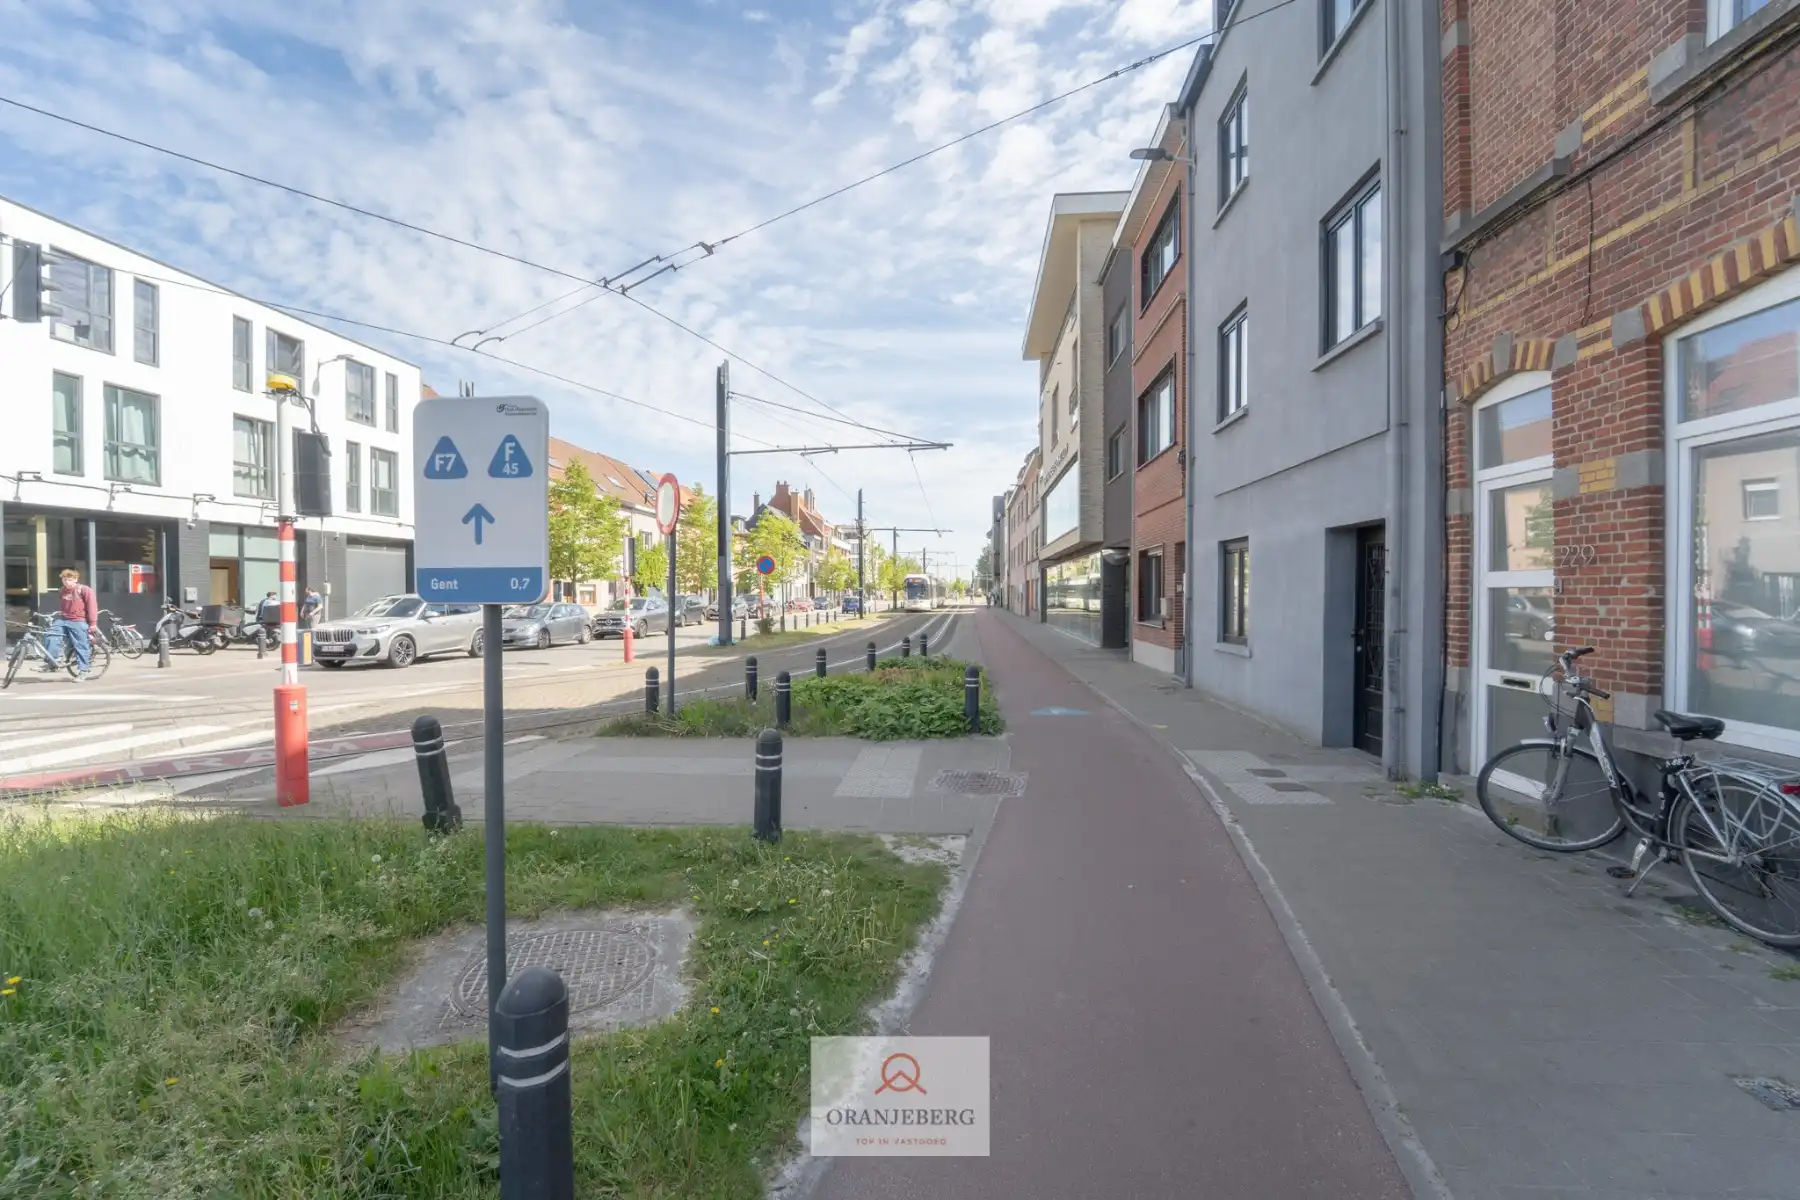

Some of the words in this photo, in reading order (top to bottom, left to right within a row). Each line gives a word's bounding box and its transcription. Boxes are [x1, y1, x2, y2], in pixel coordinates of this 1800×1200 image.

[504, 442, 516, 462] F
[435, 453, 457, 472] F7
[502, 462, 519, 475] 45
[1560, 544, 1595, 568] 229
[431, 577, 459, 590] Gent
